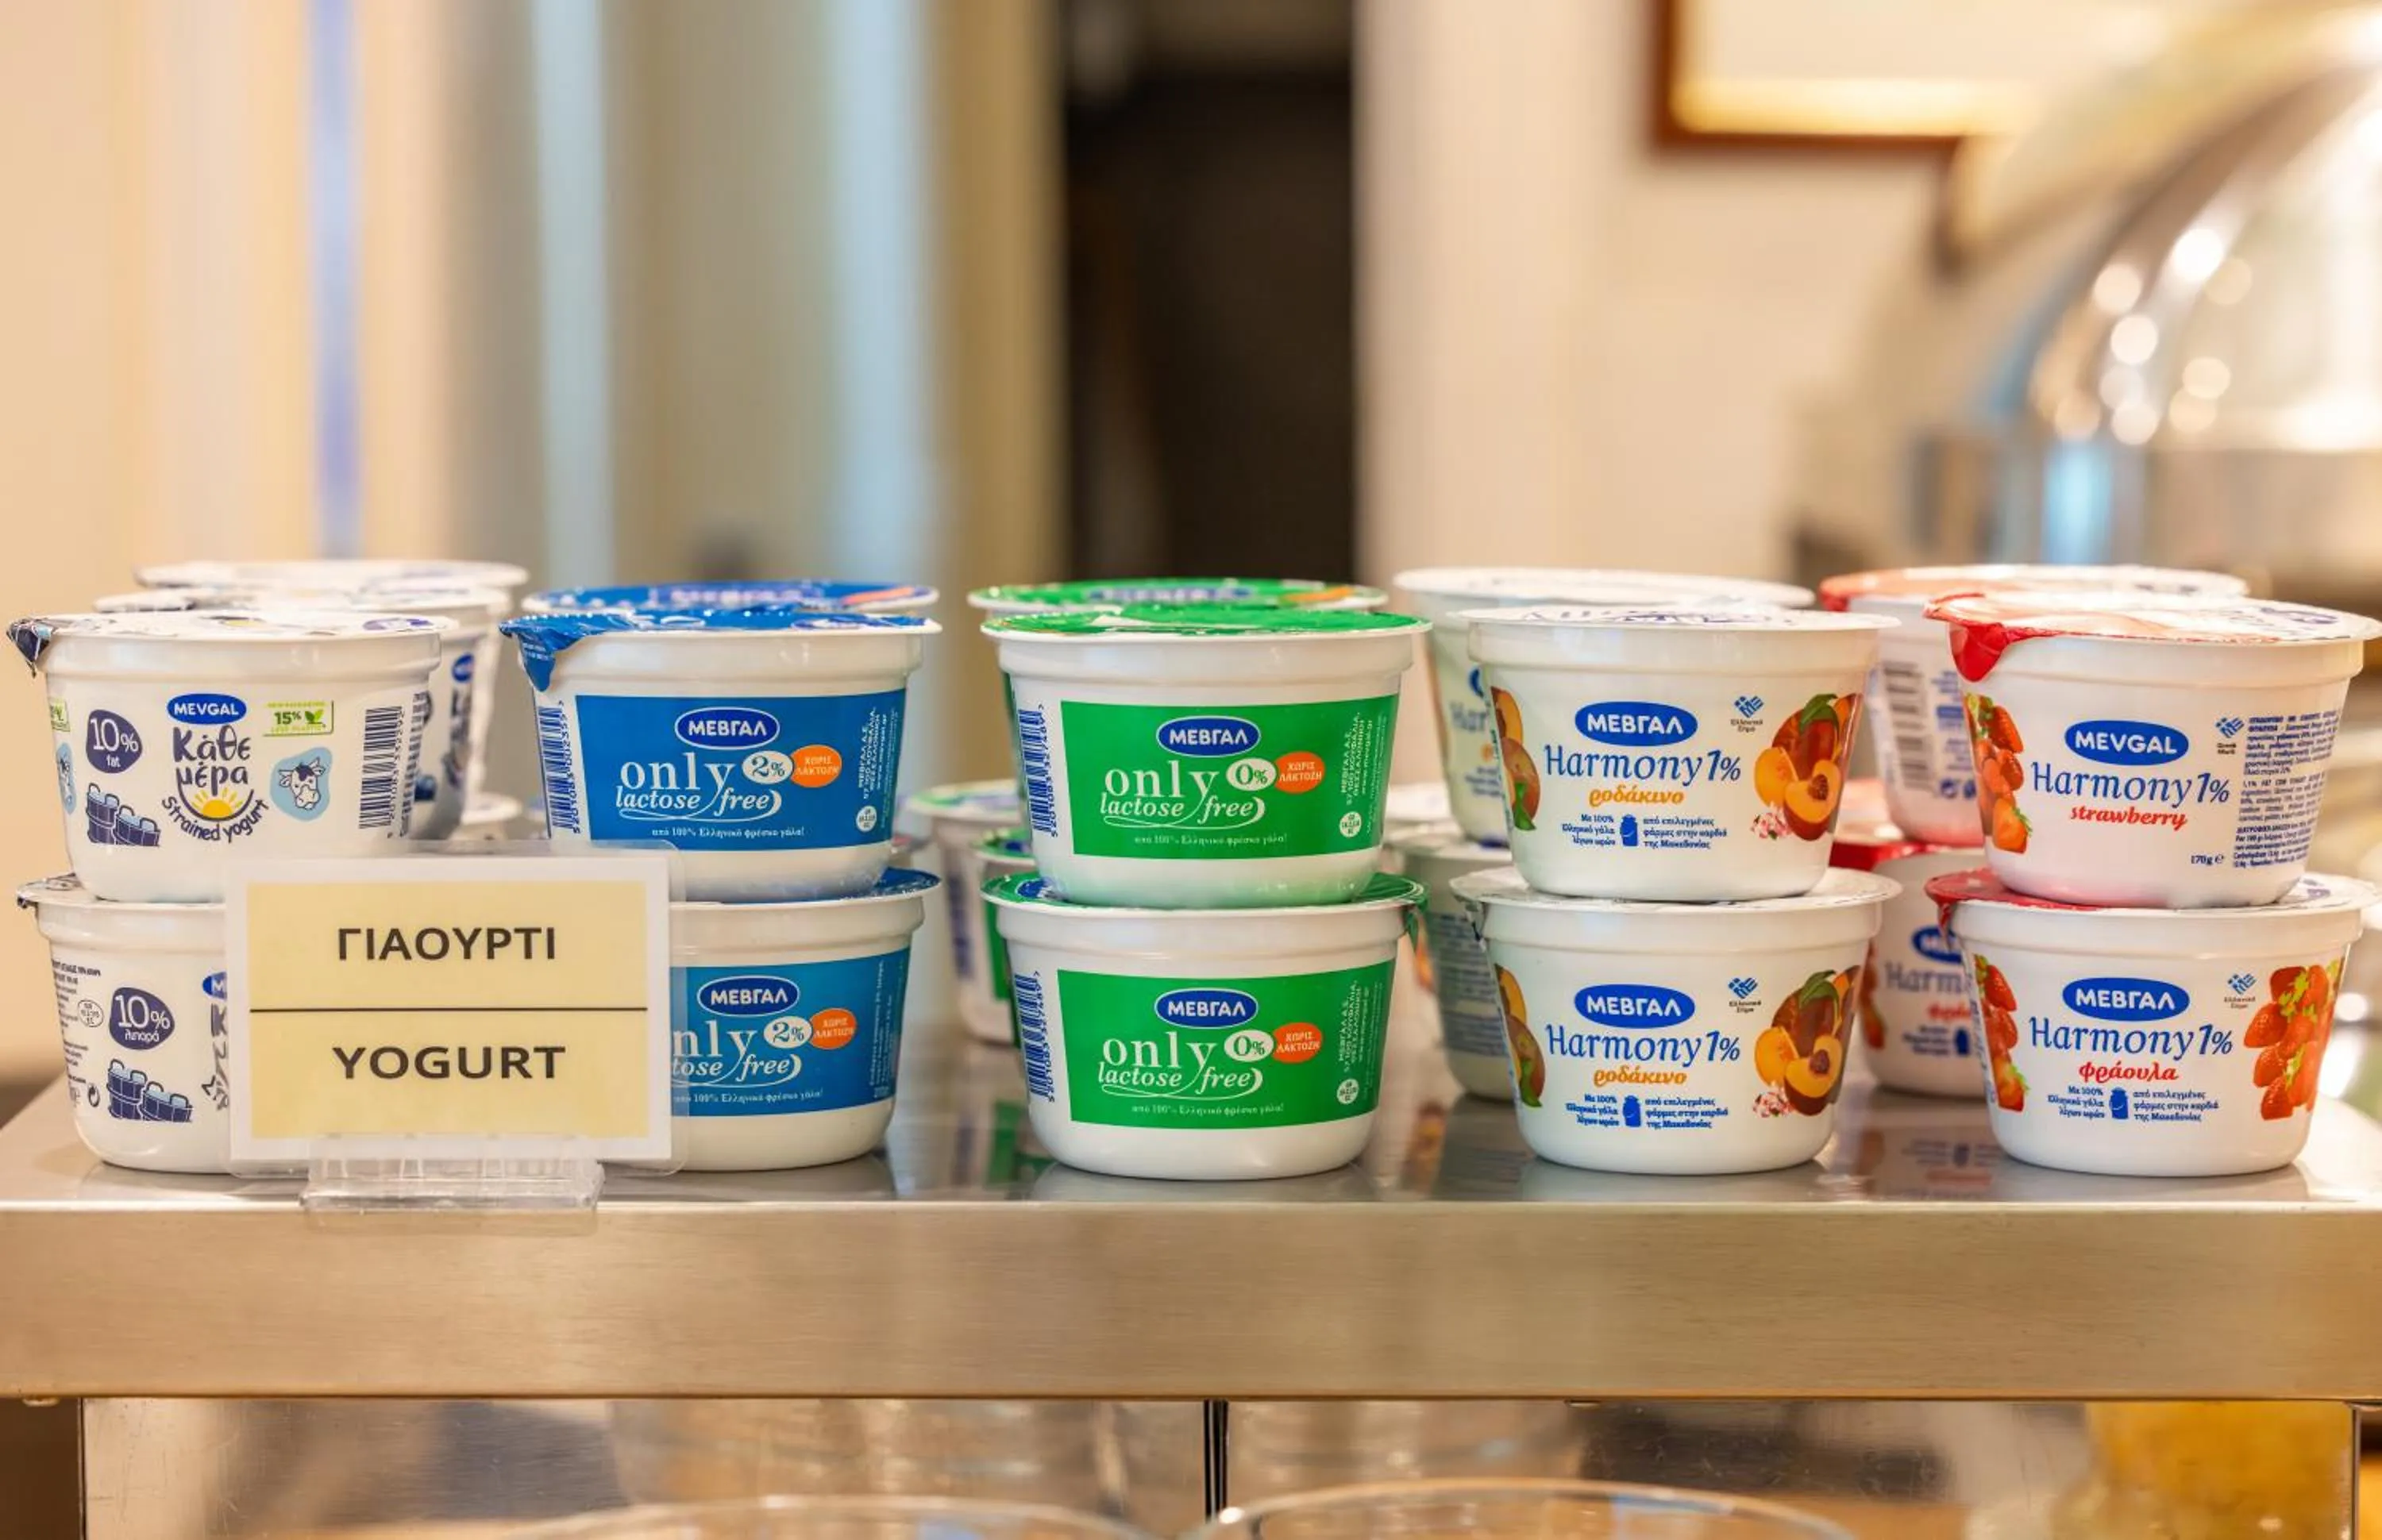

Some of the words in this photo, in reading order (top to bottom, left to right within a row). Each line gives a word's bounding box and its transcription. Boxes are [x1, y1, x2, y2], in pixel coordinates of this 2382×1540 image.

[174, 703, 238, 715] MEVGAL
[274, 710, 302, 724] 15%
[1587, 714, 1685, 735] ΜΕΒΓΑΛ
[90, 718, 139, 753] 10%
[173, 725, 252, 762] Κάθε
[688, 720, 767, 737] ΜΕΒΓΑΛ
[1169, 728, 1249, 745] ΜΕΒΓΑΛ
[2075, 732, 2178, 755] MEVGAL
[175, 762, 249, 796] μέρα
[620, 752, 736, 795] only
[751, 755, 786, 777] 2%
[1104, 760, 1220, 799] only
[1235, 764, 1267, 785] 0%
[1287, 761, 1315, 771] ΧΩΡΙΣ
[1544, 744, 1702, 787] Harmony
[1707, 749, 1741, 782] 1%
[1588, 784, 1685, 808] ροδάκινο
[2030, 761, 2193, 810] Harmony
[2197, 772, 2230, 803] 1%
[616, 786, 702, 810] lactose
[714, 787, 769, 817] free
[1100, 792, 1185, 816] lactose
[1197, 795, 1254, 824] free
[162, 796, 220, 841] Strained
[223, 799, 269, 843] yogurt
[2070, 805, 2188, 832] strawberry
[338, 927, 555, 961] ΓΙΑΟΥΡΤΙ
[115, 995, 171, 1030] 10%
[711, 988, 788, 1006] ΜΕΒΓΑΛ
[1168, 1001, 1247, 1017] ΜΕΒΓΑΛ
[1586, 995, 1682, 1016] ΜΕΒΓΑΛ
[2075, 988, 2176, 1011] ΜΕΒΓΑΛ
[673, 1019, 757, 1061] nly
[773, 1022, 804, 1043] 2%
[1103, 1032, 1217, 1070] only
[1234, 1035, 1266, 1056] 0%
[1545, 1023, 1702, 1068] Harmony
[1706, 1031, 1740, 1062] 1%
[2029, 1017, 2193, 1061] Harmony
[2198, 1023, 2233, 1055] 1%
[333, 1045, 566, 1080] YOGURT
[673, 1058, 723, 1076] tose
[736, 1053, 791, 1082] free
[1098, 1061, 1182, 1087] lactose
[1196, 1066, 1251, 1095] free
[1593, 1065, 1687, 1088] ροδάκινο
[2078, 1061, 2179, 1084] φράουλα
